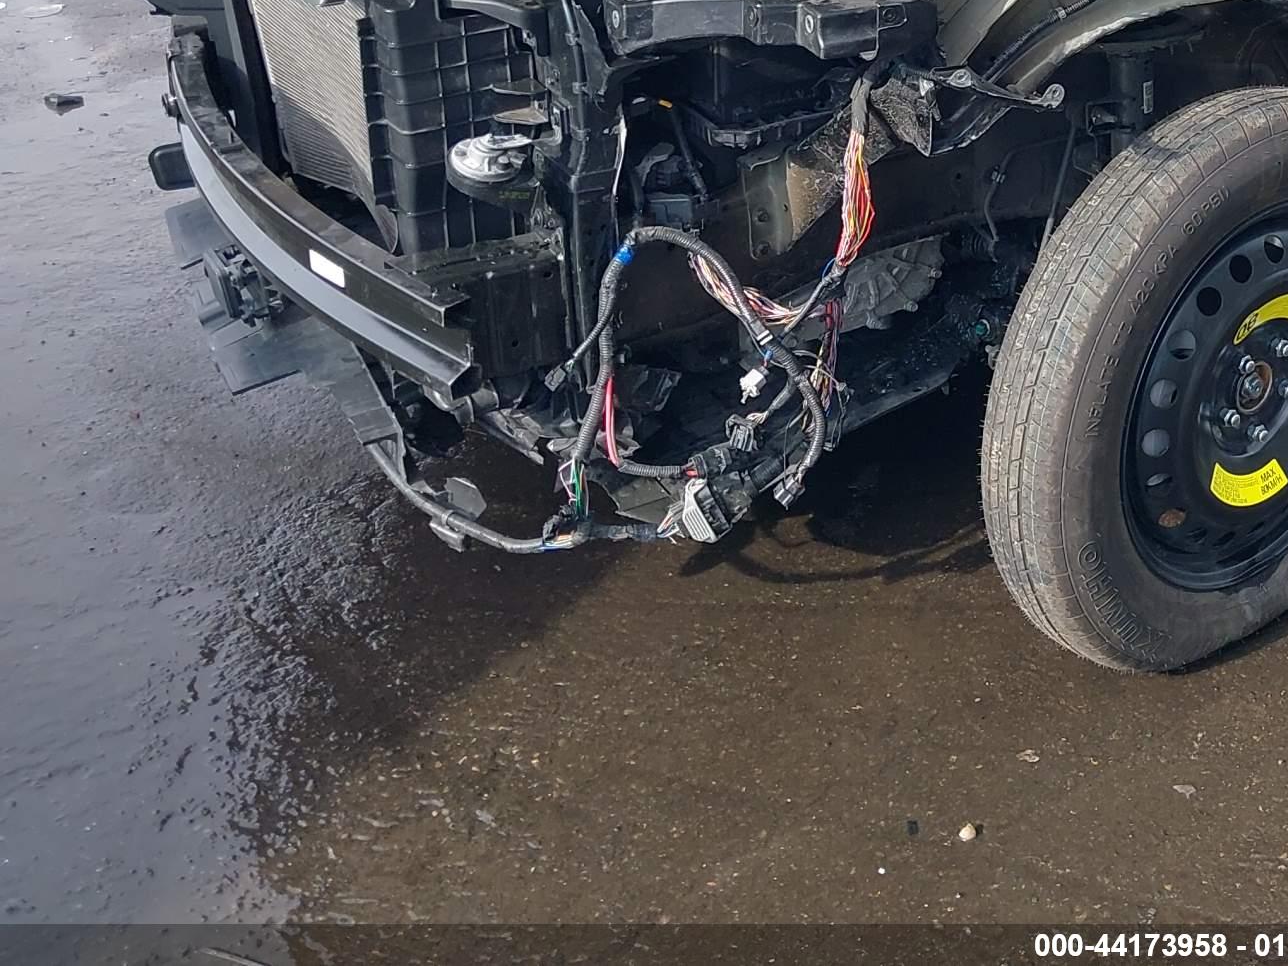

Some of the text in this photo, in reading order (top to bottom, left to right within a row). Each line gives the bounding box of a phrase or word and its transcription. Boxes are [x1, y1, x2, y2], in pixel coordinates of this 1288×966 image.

[1085, 353, 1120, 438] INFLATE
[1152, 244, 1179, 277] KPA
[1260, 466, 1277, 483] MAX
[1077, 540, 1173, 663] KUMHO
